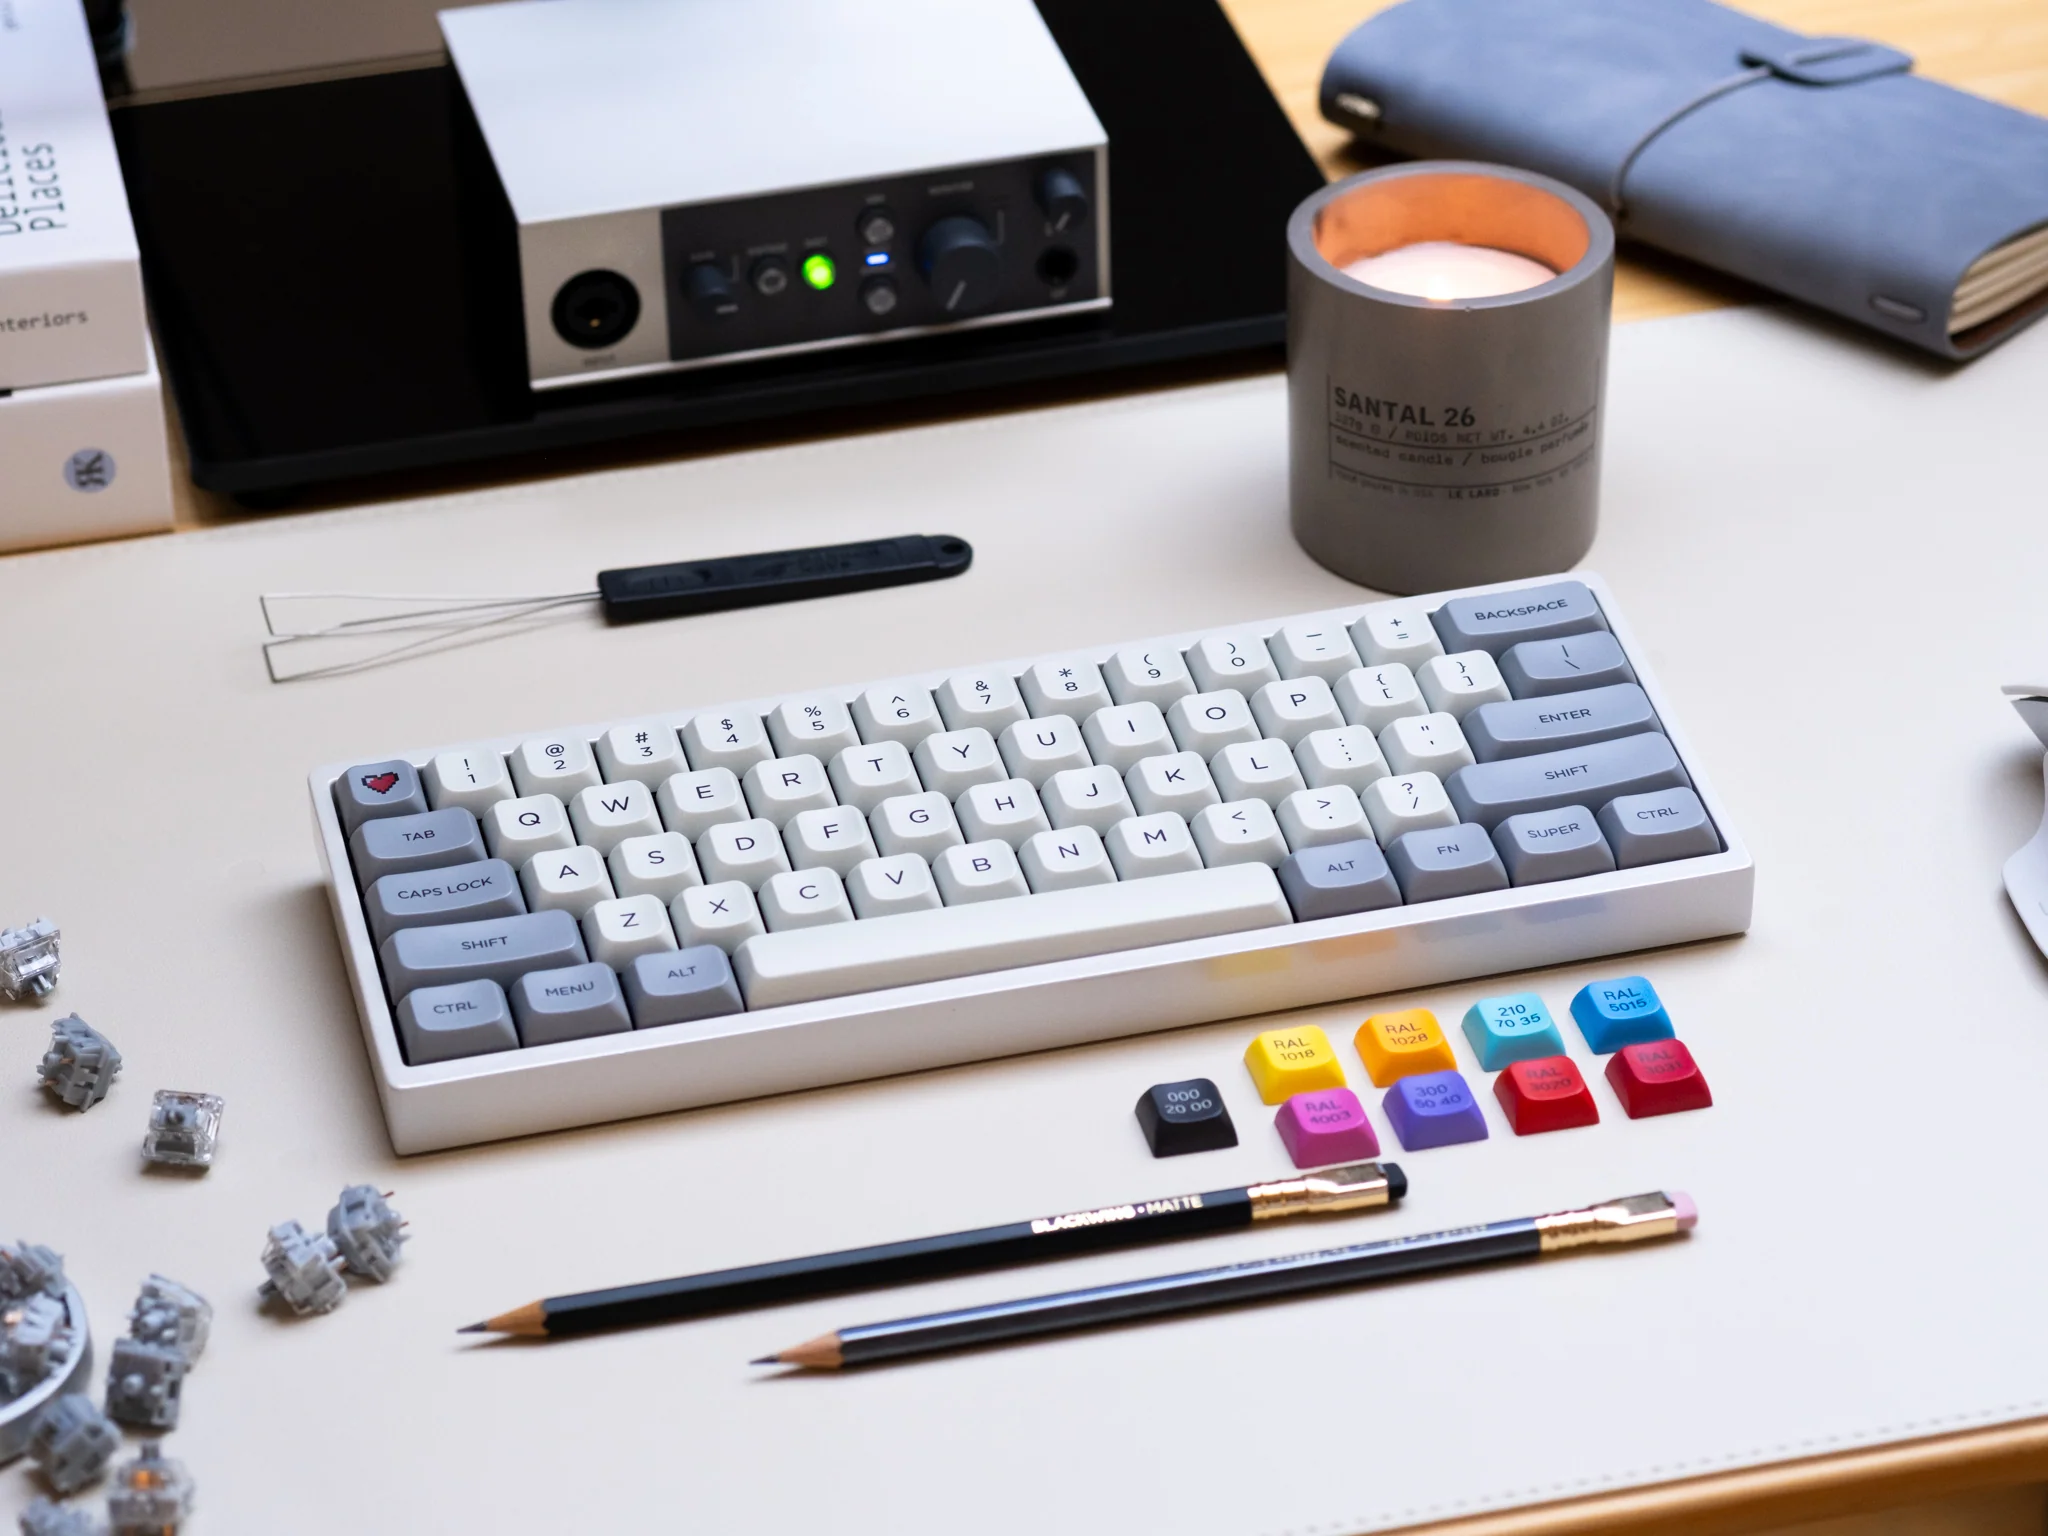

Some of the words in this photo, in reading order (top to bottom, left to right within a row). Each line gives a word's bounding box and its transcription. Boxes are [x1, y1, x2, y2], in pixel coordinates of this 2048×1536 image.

[21, 142, 69, 232] places
[1334, 386, 1435, 427] SANTAL
[1444, 406, 1476, 428] 26
[1456, 430, 1481, 444] NET
[1398, 451, 1453, 466] candle
[1480, 446, 1533, 465] bougie
[1474, 599, 1569, 621] BACKSPACE
[1390, 618, 1402, 627] +
[1227, 643, 1236, 654] )
[1143, 654, 1153, 666] (
[1147, 669, 1161, 679] 9
[1456, 662, 1466, 673] }
[975, 680, 989, 691] &
[1065, 681, 1078, 692] 8
[1376, 674, 1386, 686] {
[1462, 676, 1474, 686] ]
[891, 695, 905, 704] ^
[980, 694, 991, 705] 7
[1290, 693, 1307, 707] P
[1382, 688, 1393, 699] [
[804, 705, 822, 718] %
[897, 708, 910, 718] 6
[1205, 706, 1227, 720] O
[1538, 708, 1592, 724] ENTER
[721, 718, 733, 731] $
[812, 720, 825, 731] 5
[1127, 719, 1135, 733] I
[634, 732, 649, 744] #
[726, 734, 739, 744] 4
[1036, 732, 1056, 747] U
[545, 743, 565, 757] @
[640, 747, 653, 756] 3
[952, 744, 970, 759] Y
[464, 758, 470, 771] !
[554, 760, 567, 770] 2
[867, 758, 884, 772] T
[1250, 756, 1269, 770] L
[468, 774, 476, 783] 1
[1165, 768, 1185, 783] K
[1544, 764, 1589, 780] SHIFT
[781, 772, 802, 787] R
[695, 784, 714, 799] E
[1086, 782, 1099, 797] J
[1401, 782, 1414, 794] ?
[601, 796, 630, 813] W
[994, 795, 1015, 811] H
[1317, 799, 1331, 809] >
[518, 812, 540, 826] Q
[909, 810, 930, 823] G
[1231, 811, 1246, 820] <
[1637, 806, 1680, 820] CTRL
[402, 829, 435, 841] TAB
[823, 823, 839, 838] F
[1143, 829, 1167, 844] M
[1527, 822, 1580, 839] SUPER
[735, 837, 755, 851] D
[1058, 843, 1080, 859] N
[1437, 844, 1460, 856] FN
[648, 850, 664, 864] S
[558, 864, 579, 879] A
[972, 858, 991, 872] B
[1327, 860, 1355, 872] ALT
[885, 870, 903, 885] V
[397, 887, 443, 900] CAPS
[447, 876, 493, 895] LOCK
[799, 885, 819, 899] C
[708, 899, 729, 914] X
[620, 913, 639, 928] Z
[461, 935, 508, 951] SHIFT
[667, 966, 697, 979] ALT
[545, 981, 594, 998] MENU
[1604, 988, 1641, 1000] RAL
[433, 1000, 478, 1015] CTRL
[1498, 1004, 1526, 1016] 210
[1609, 998, 1647, 1012] 5015
[1385, 1022, 1422, 1034] RAL
[1496, 1018, 1516, 1028] 70
[1520, 1014, 1541, 1026] 35
[1273, 1038, 1311, 1050] RAL
[1390, 1033, 1428, 1046] 1028
[1280, 1050, 1316, 1061] 1018
[1636, 1050, 1675, 1062] RAL
[1526, 1067, 1562, 1080] RAL
[1415, 1084, 1448, 1097] 300
[1530, 1078, 1572, 1092] 3020
[1166, 1103, 1186, 1114] 20
[1306, 1100, 1342, 1112] RAL
[1414, 1099, 1436, 1109] 50
[1440, 1095, 1461, 1105] 40
[1310, 1112, 1352, 1124] 4003
[1031, 1205, 1136, 1233] BLACKWING
[1147, 1195, 1205, 1214] MATTE
